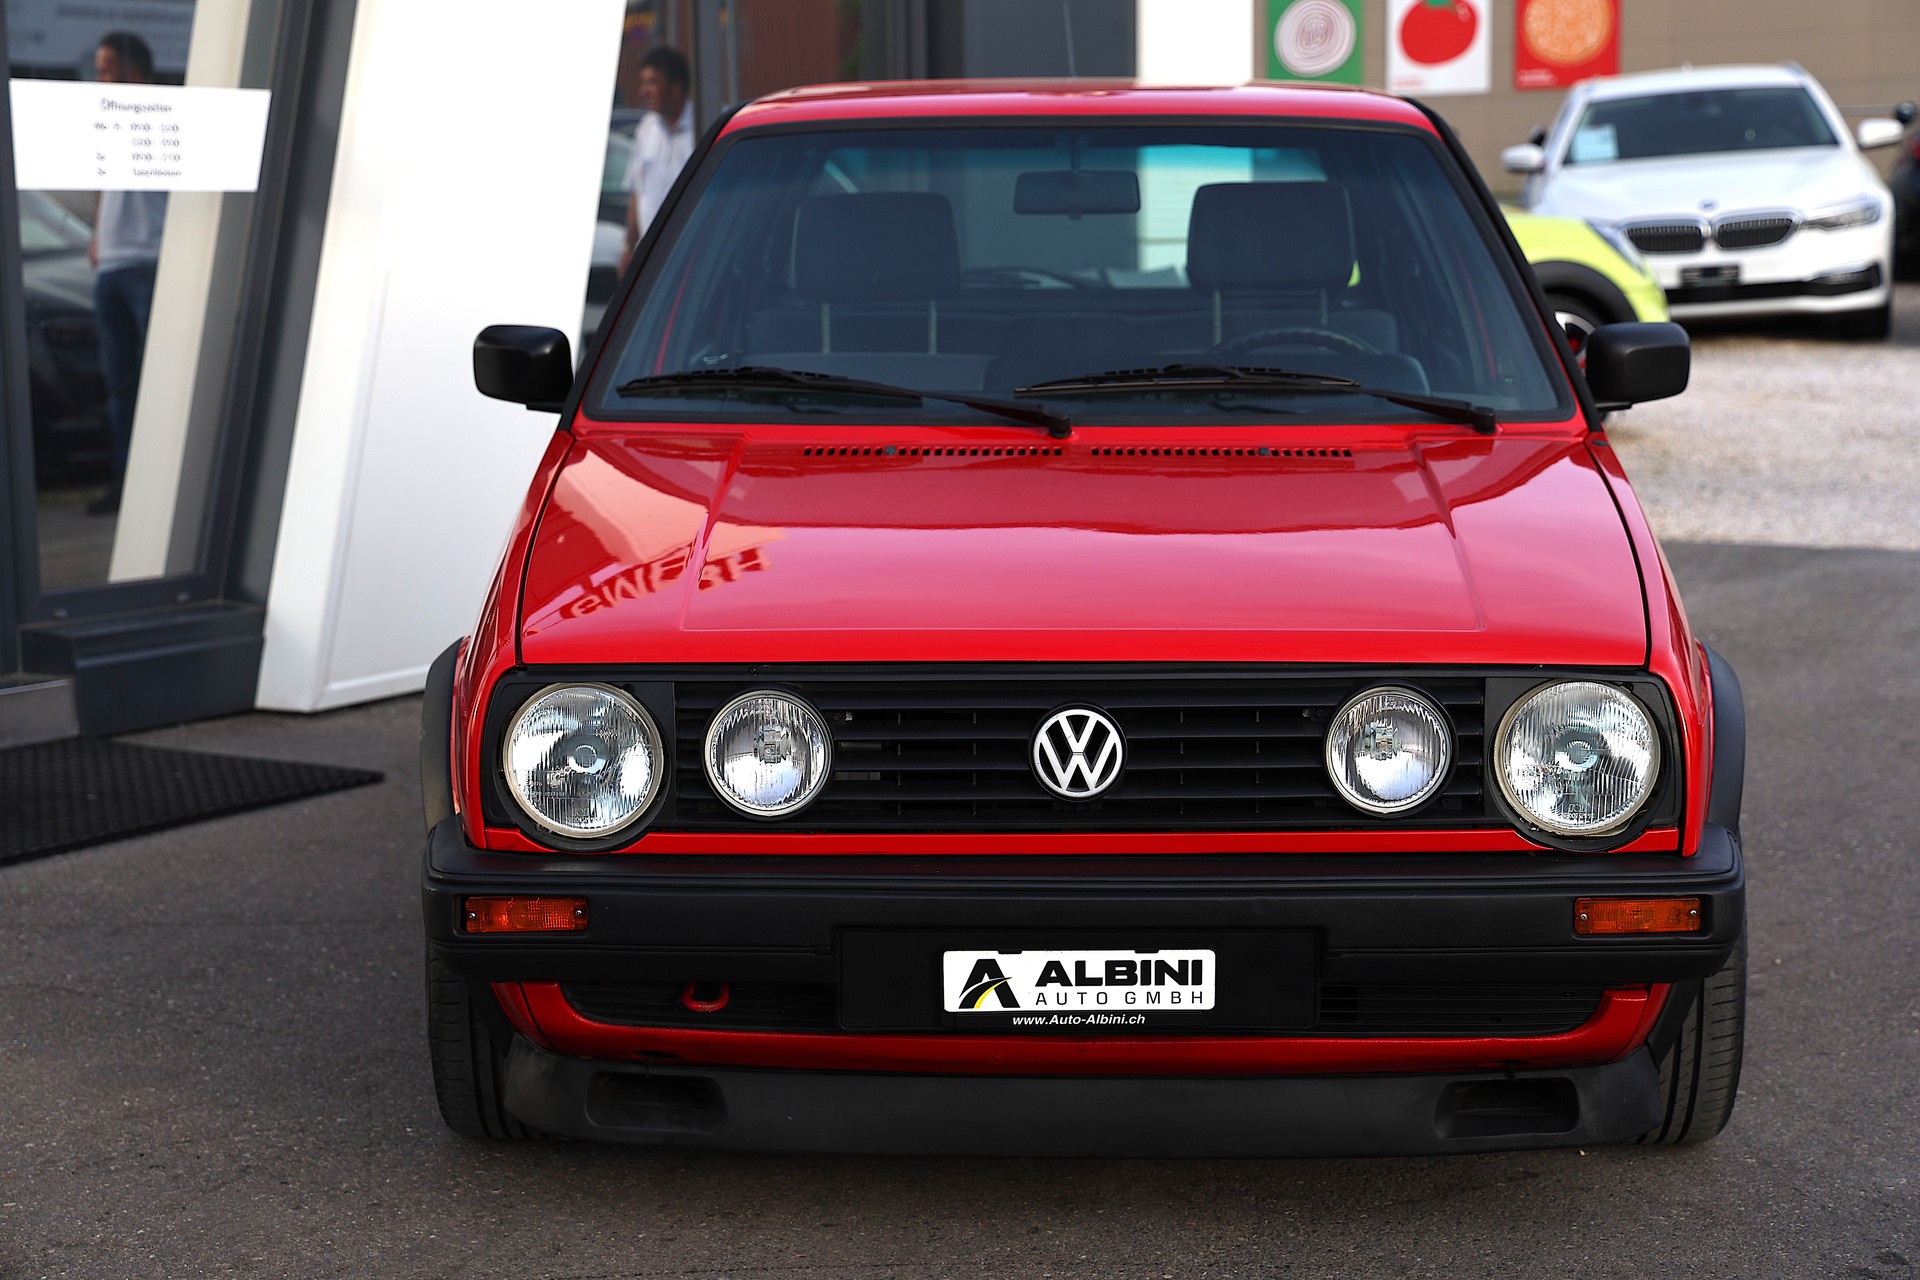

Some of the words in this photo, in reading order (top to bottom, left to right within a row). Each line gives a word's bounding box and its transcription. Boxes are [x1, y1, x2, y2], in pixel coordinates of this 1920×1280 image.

[1033, 708, 1123, 798] VW
[1035, 959, 1203, 987] ALBINI
[1035, 992, 1108, 1006] AUTO
[1125, 991, 1203, 1005] GMBH
[1012, 1013, 1146, 1026] www.Auto-Albini.ch
